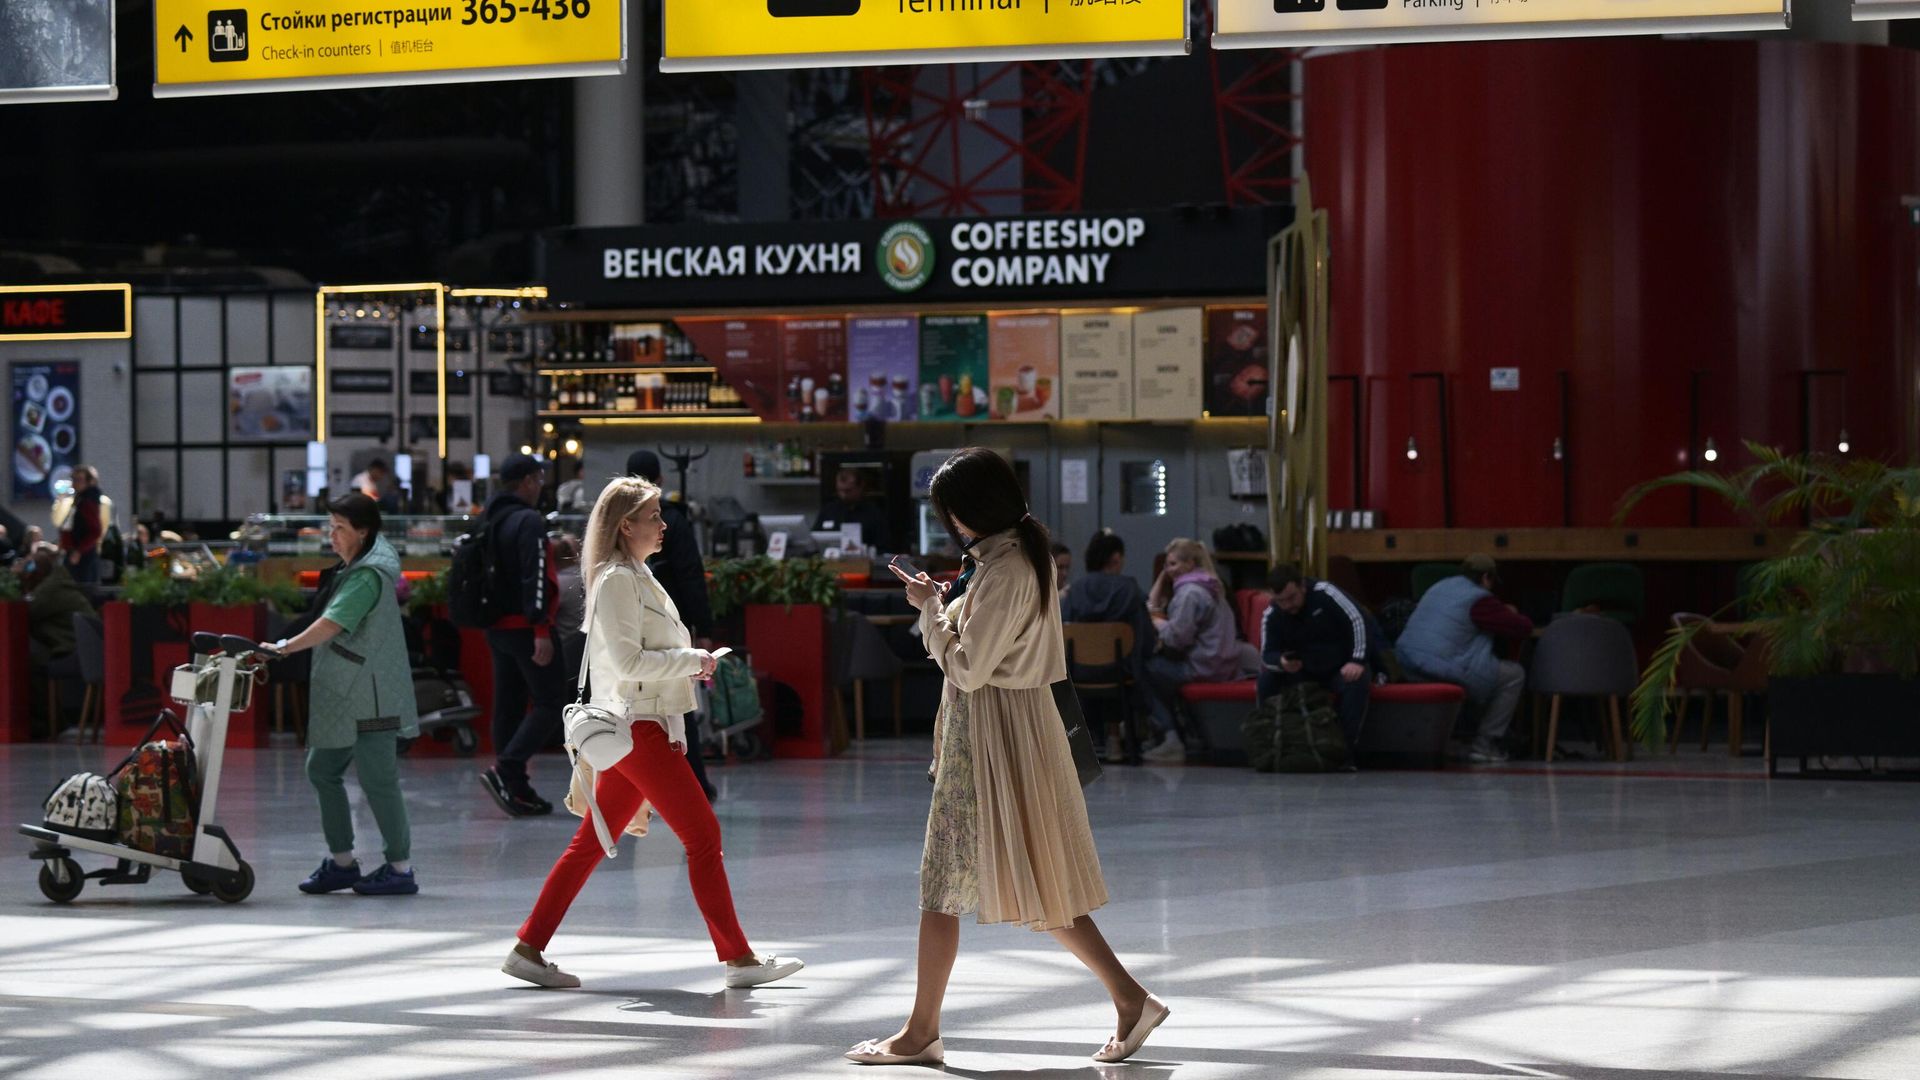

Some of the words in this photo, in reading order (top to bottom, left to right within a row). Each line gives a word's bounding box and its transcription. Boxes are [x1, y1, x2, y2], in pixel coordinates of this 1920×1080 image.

[261, 12, 326, 31] Стойки
[331, 7, 452, 32] регистрации
[461, 0, 591, 26] 365-436
[262, 43, 314, 60] Check-in
[317, 42, 372, 58] counters
[390, 38, 434, 55] 值机柜台
[951, 218, 1144, 251] COFFEESHOP
[604, 245, 746, 278] ВЕНСКАЯ
[755, 242, 860, 274] КУХНЯ
[951, 253, 1109, 287] COMPANY
[3, 297, 65, 326] КАФЕ
